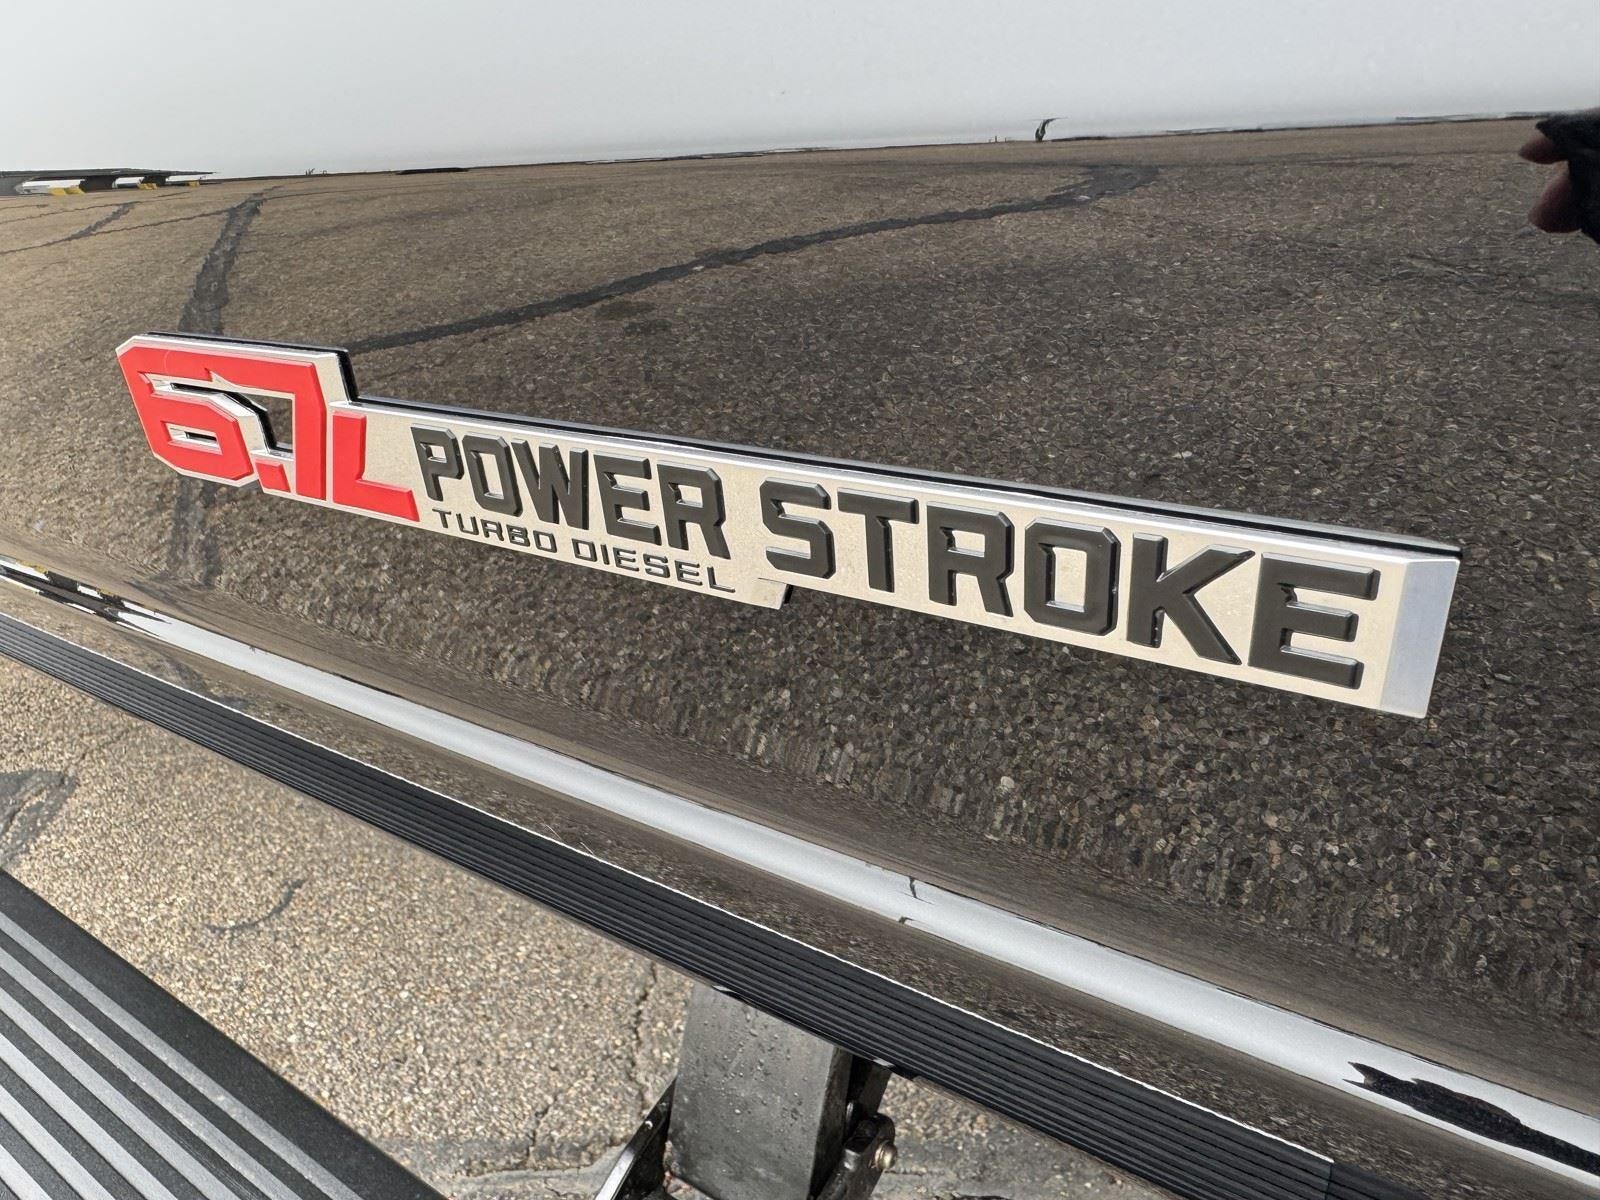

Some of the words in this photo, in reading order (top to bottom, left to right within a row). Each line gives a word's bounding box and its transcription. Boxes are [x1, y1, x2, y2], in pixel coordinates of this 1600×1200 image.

[117, 340, 420, 522] 6.7L
[410, 424, 731, 559] POWER
[759, 479, 1381, 689] STROKE
[432, 507, 557, 553] TURBO
[572, 540, 736, 593] DIESEL
